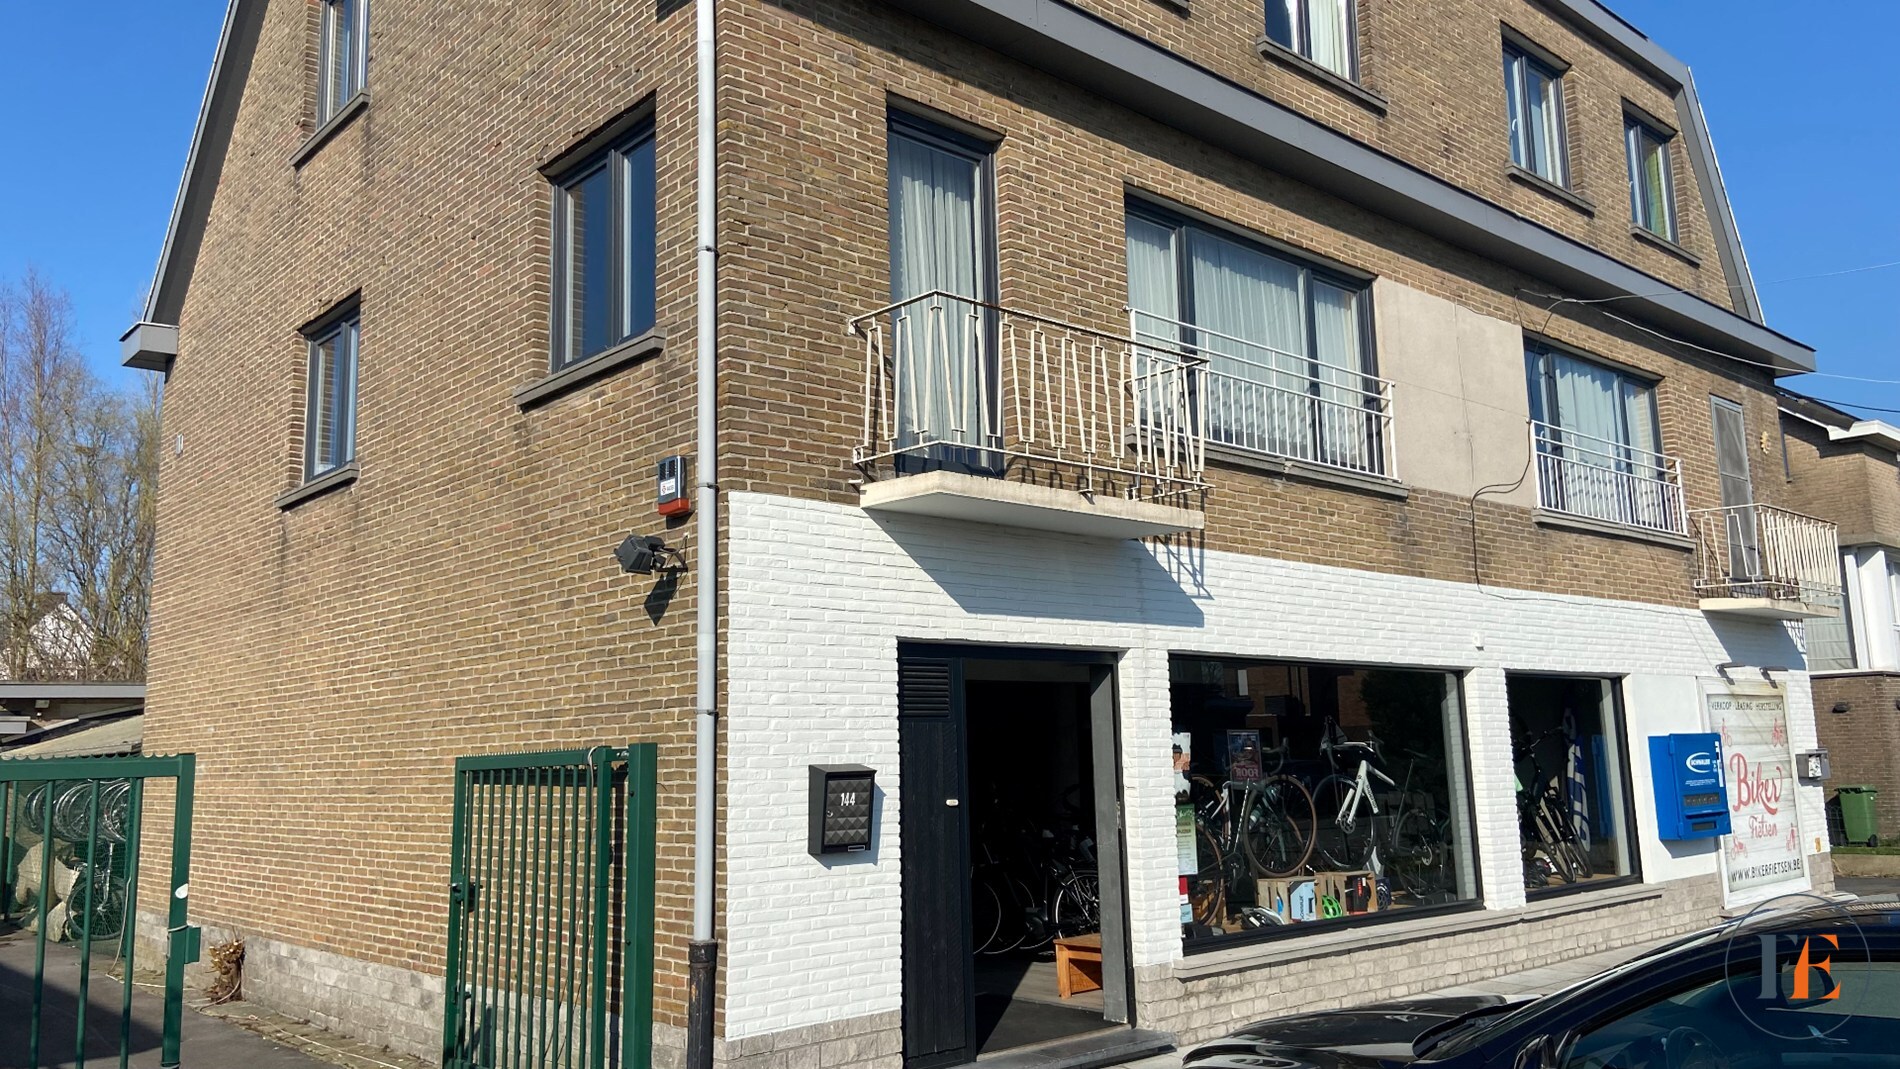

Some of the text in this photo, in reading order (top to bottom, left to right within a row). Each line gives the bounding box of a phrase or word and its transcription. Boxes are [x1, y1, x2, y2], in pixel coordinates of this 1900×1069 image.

[1711, 701, 1782, 711] VERKOOP LEASING HERSTELLING
[1729, 752, 1783, 815] Biker
[840, 792, 856, 806] 144
[1748, 814, 1778, 838] Fietsen
[1731, 858, 1801, 882] WWW.BIKERFIETSEN.BE
